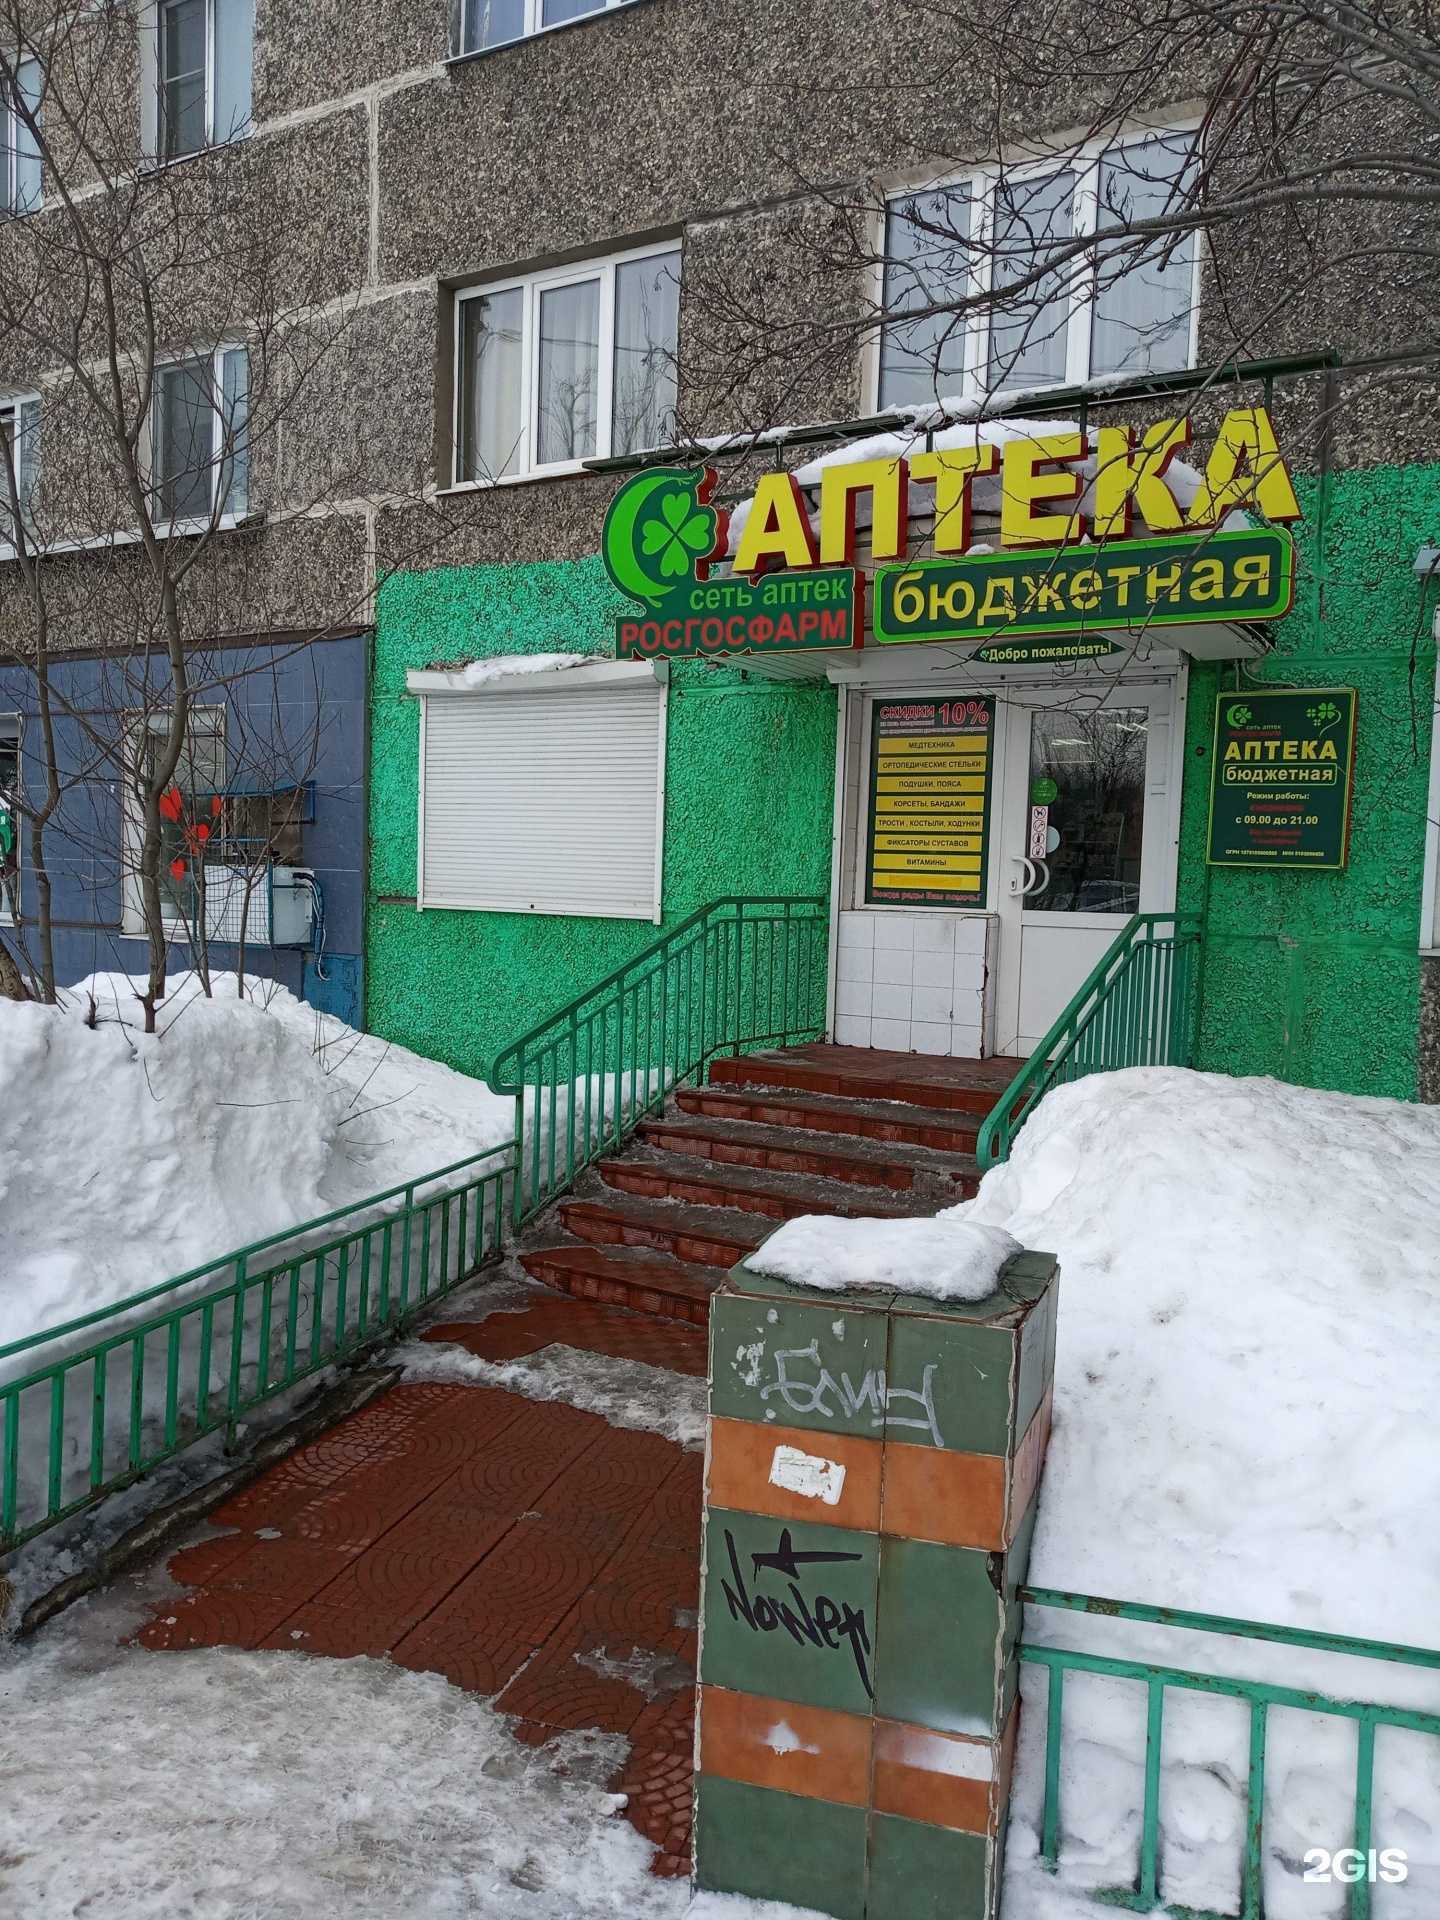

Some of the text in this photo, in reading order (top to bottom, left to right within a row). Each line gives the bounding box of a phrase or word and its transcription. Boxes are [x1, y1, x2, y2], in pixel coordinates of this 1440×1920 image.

[731, 407, 1301, 573] АПТЕКА
[690, 577, 847, 610] сеть аптек
[892, 553, 1270, 625] бюджетная
[620, 609, 847, 653] РОСГОСФАРМ
[989, 641, 1112, 662] Добро пожаловать!
[880, 700, 989, 725] СКИДКИ 10%
[908, 741, 955, 749] МЕДТЕХНИКА
[1224, 740, 1338, 761] АПТЕКА
[882, 761, 947, 769] ОРТОПЕДИЧЕСКИЕ
[1226, 766, 1333, 783] бюджетная
[936, 780, 961, 788] ПОЯСА
[1275, 792, 1310, 801] работы:
[930, 800, 966, 808] БАНДАЖИ
[948, 820, 981, 829] ХОДУНКИ
[1244, 815, 1271, 824] 09.00
[1273, 816, 1288, 826] до
[1290, 815, 1319, 825] 21.00
[886, 839, 969, 848] ФИКСАТОРЫ СУСТАВОВ
[906, 858, 947, 866] ВИТАМИНЫ
